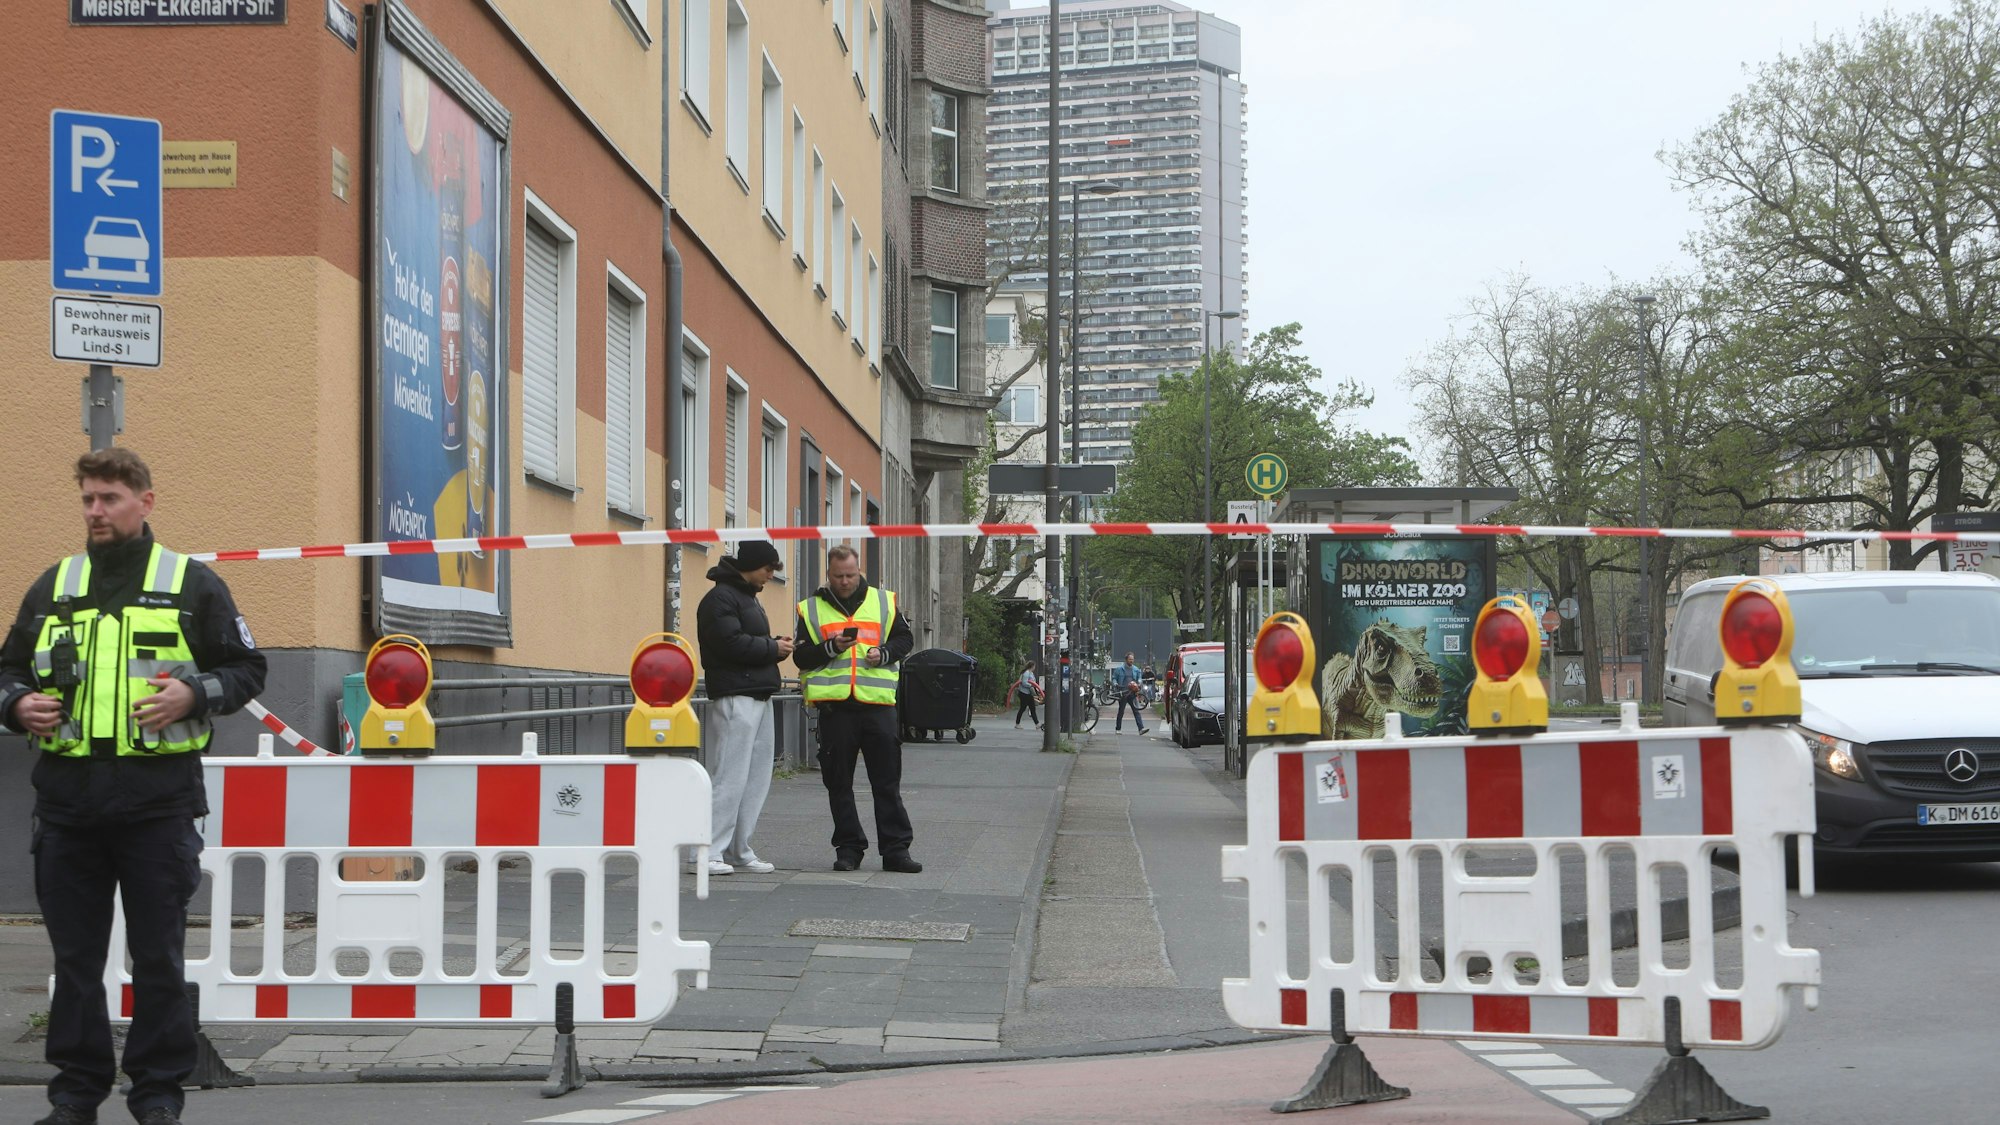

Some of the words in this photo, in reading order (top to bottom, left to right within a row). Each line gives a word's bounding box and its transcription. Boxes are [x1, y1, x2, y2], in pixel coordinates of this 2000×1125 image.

[82, 0, 275, 16] Meister-Ekkehart-Str.
[71, 124, 116, 193] P
[395, 262, 409, 302] Hol
[409, 270, 420, 308] dir
[420, 277, 434, 317] den
[64, 306, 128, 322] Bewohner
[131, 312, 151, 324] mit
[72, 323, 150, 341] Parkausweis
[83, 341, 123, 355] Lind-S
[383, 313, 430, 376] cremigen
[1257, 463, 1277, 485] H
[389, 500, 427, 540] MÖVENPICK
[1232, 513, 1253, 536] A
[1341, 561, 1467, 581] DINOWORLD
[1341, 584, 1362, 599] IM
[1365, 581, 1429, 599] KÖLNER
[1432, 583, 1467, 598] ZOO
[1928, 807, 1937, 821] K
[1948, 807, 1968, 821] DM
[1971, 806, 2000, 821] 616
